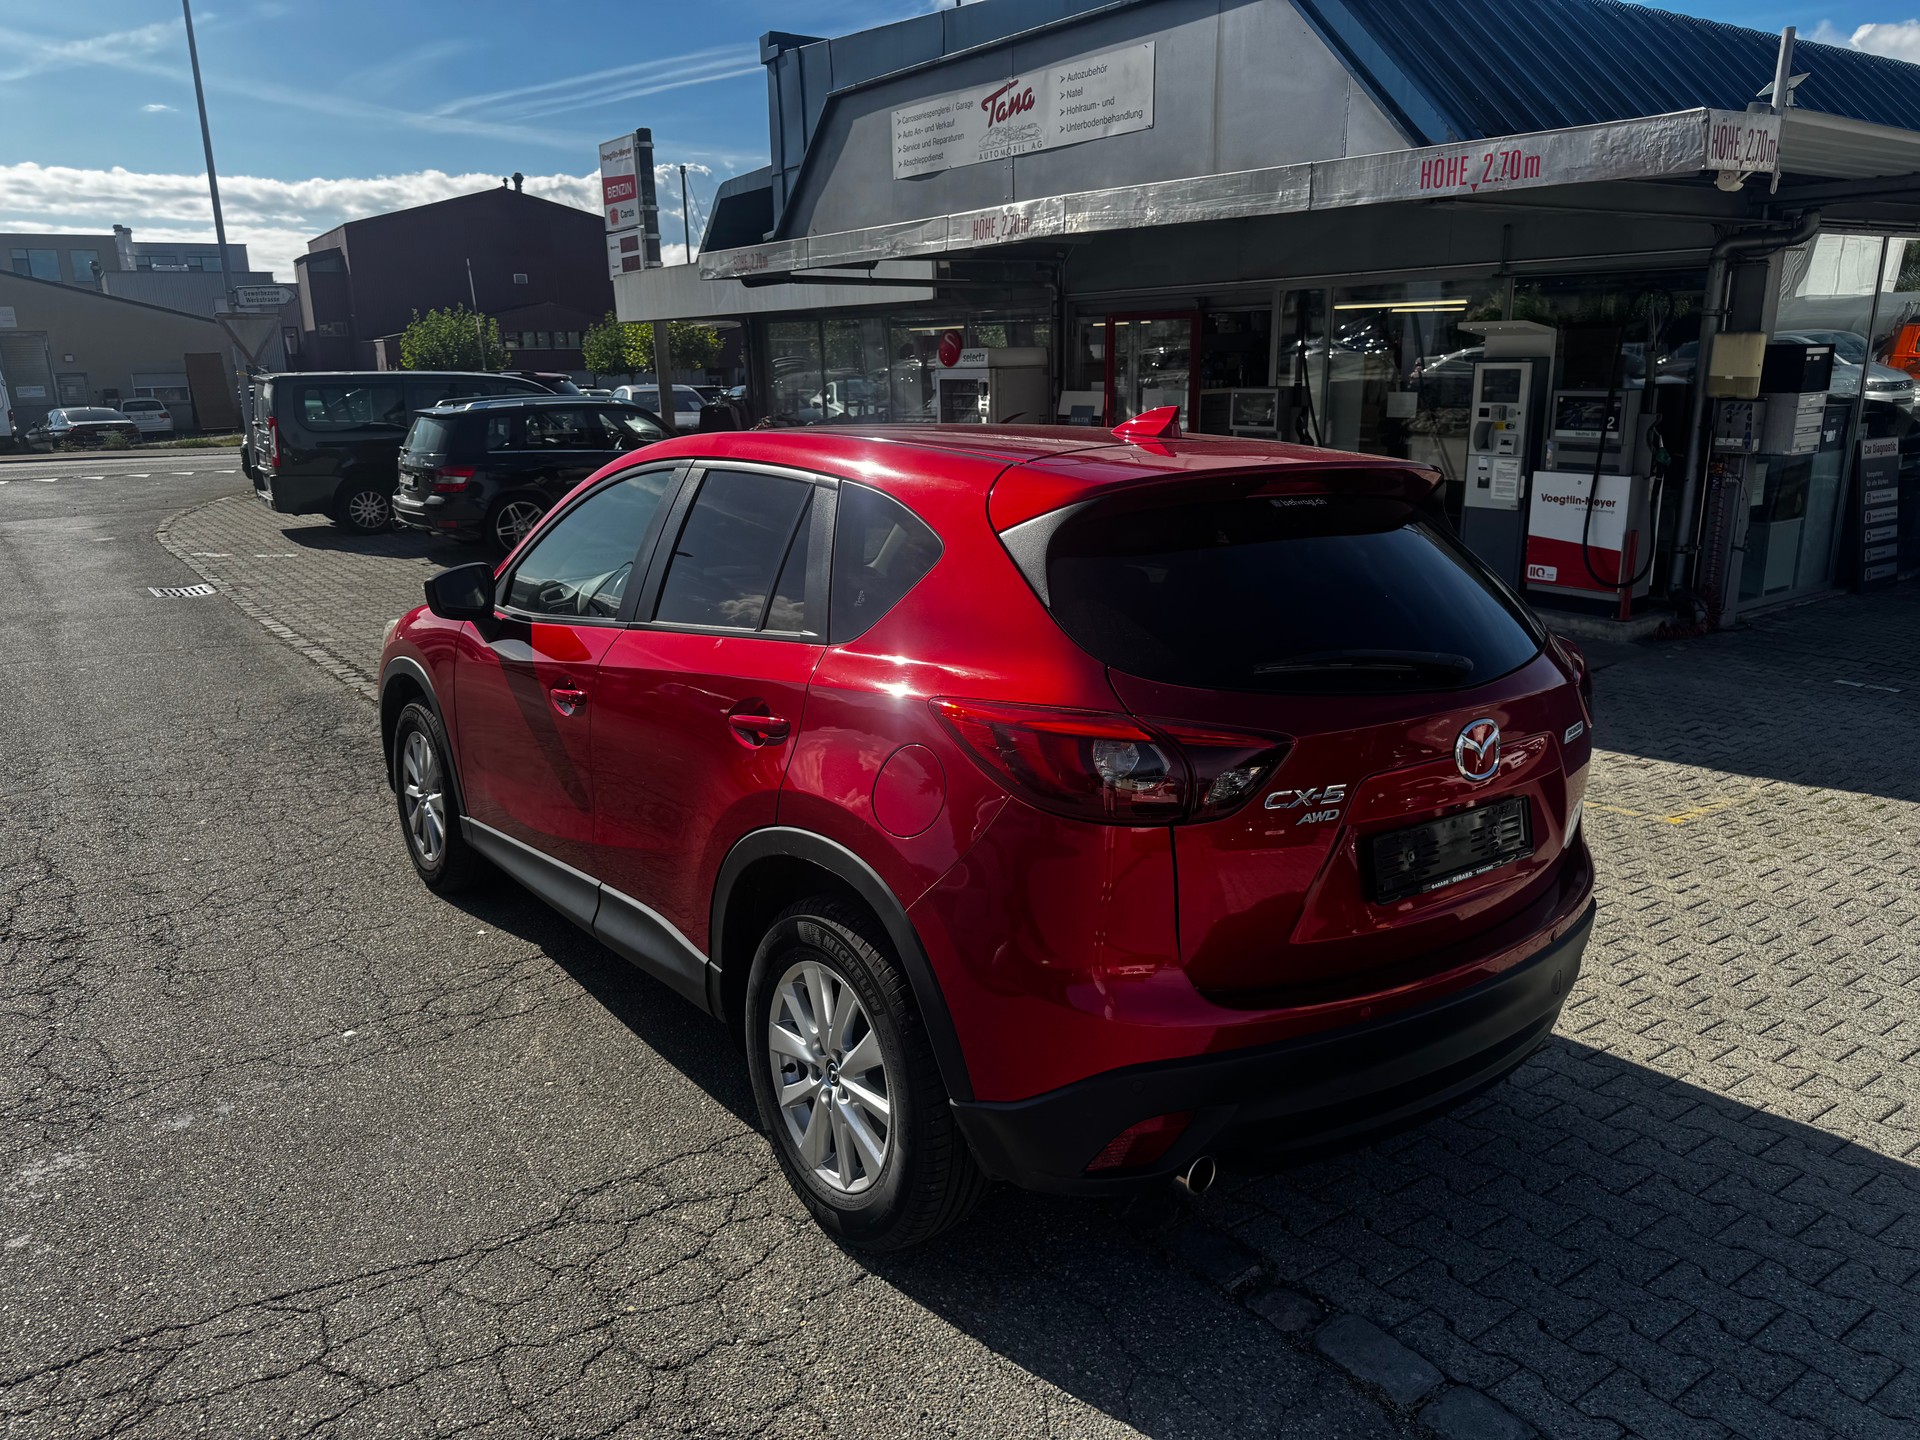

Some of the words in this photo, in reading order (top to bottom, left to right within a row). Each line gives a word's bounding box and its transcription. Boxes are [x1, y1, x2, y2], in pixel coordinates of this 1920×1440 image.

[1067, 64, 1108, 82] Autozubehör
[1067, 87, 1083, 99] Natel
[1102, 96, 1115, 107] und
[956, 100, 974, 111] Garage
[981, 79, 1036, 128] Tana
[902, 130, 914, 139] Auto
[925, 123, 935, 133] und
[936, 118, 955, 130] Verkauf
[1067, 109, 1143, 132] Unterbodenbehandlung
[903, 143, 921, 153] Service
[922, 139, 931, 148] und
[933, 133, 965, 147] Reparaturen
[1711, 117, 1741, 161] HÖHE
[979, 144, 1025, 161] AUTOMOBIL
[1031, 140, 1043, 151] AG
[903, 152, 944, 168] Abschleppdienst
[1420, 152, 1469, 190] HÖHE
[607, 181, 633, 199] BENZIN
[620, 208, 635, 219] Cards
[973, 214, 996, 240] HÖHE
[963, 352, 985, 362] selecta
[1606, 416, 1615, 430] 2
[1864, 444, 1872, 455] Car
[1872, 441, 1897, 456] Diagnostic
[1264, 783, 1347, 810] CX-5
[1295, 808, 1340, 826] AWD
[822, 935, 883, 1013] MICHELIN
